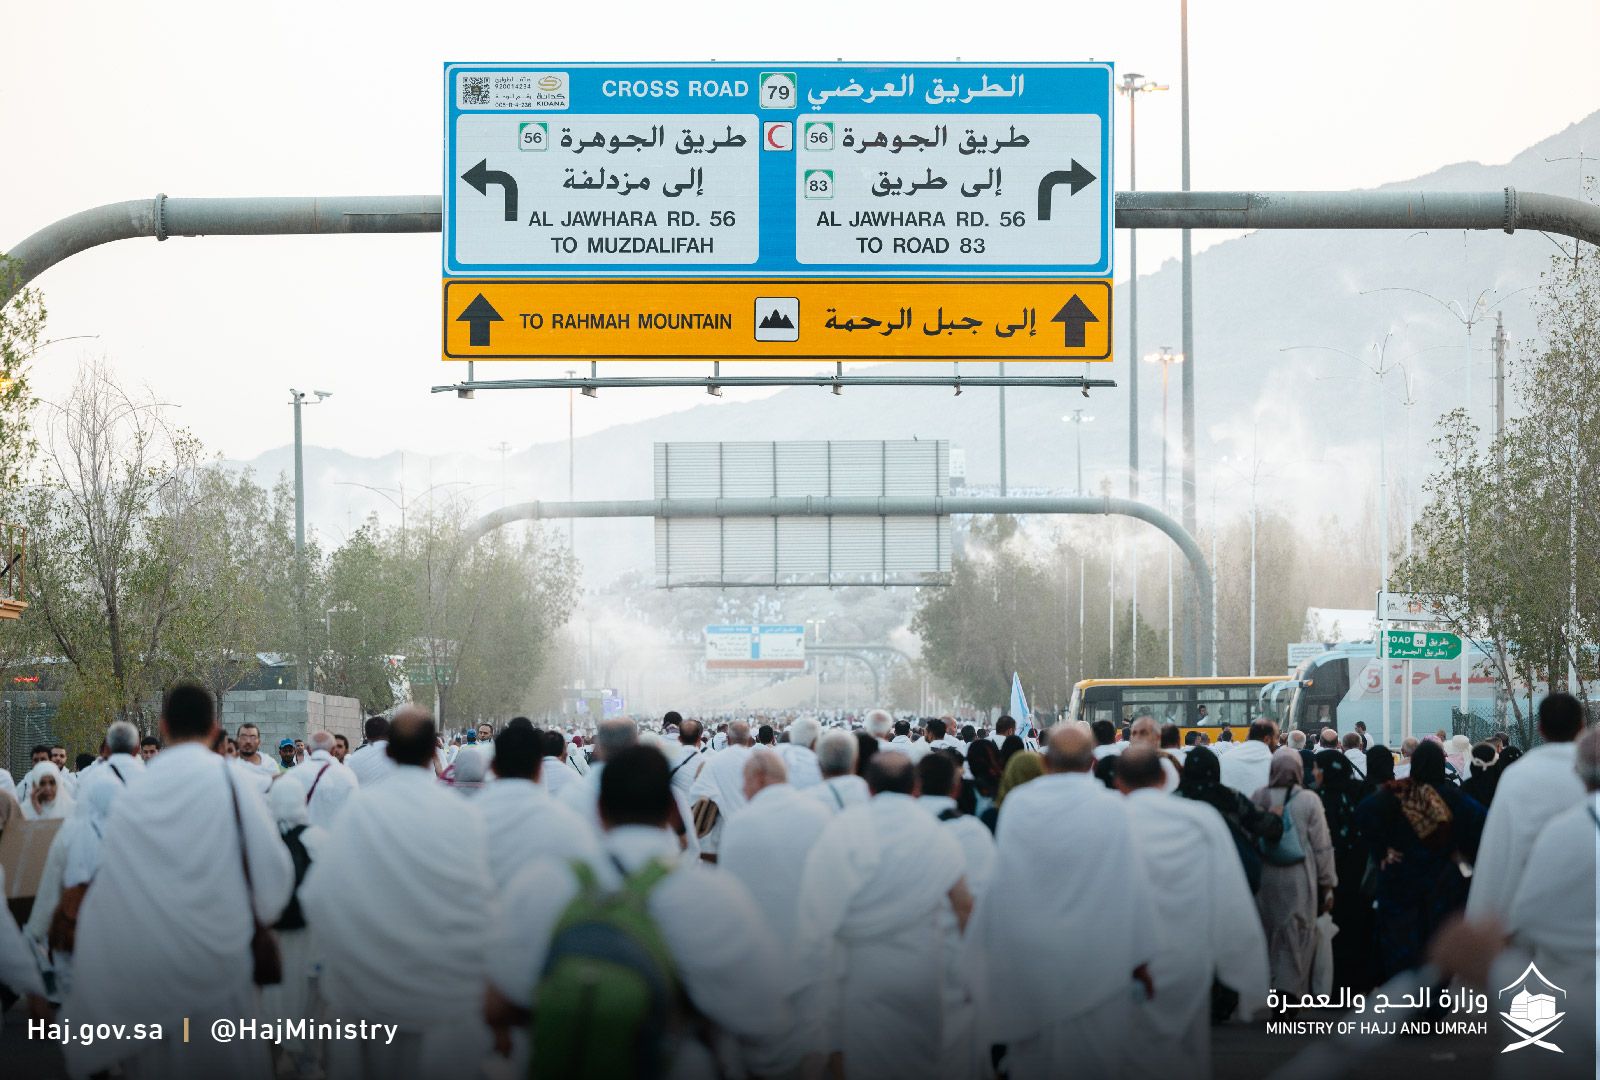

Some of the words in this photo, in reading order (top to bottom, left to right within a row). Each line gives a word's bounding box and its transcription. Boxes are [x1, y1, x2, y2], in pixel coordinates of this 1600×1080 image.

[602, 80, 679, 97] CROSS
[689, 80, 748, 97] ROAD
[768, 86, 789, 99] 79
[808, 74, 914, 110] العرضي
[926, 74, 1024, 104] الطريق
[524, 133, 542, 143] 56
[561, 125, 664, 154] الجوهرة
[675, 125, 747, 154] طريق
[810, 132, 827, 143] 56
[843, 125, 947, 154] الجوهرة
[959, 125, 1030, 155] طريق
[563, 167, 650, 196] مزدلفة
[663, 167, 703, 197] إلى
[810, 180, 827, 191] 83
[872, 168, 947, 197] طريق
[961, 167, 1001, 197] إلى
[529, 211, 553, 226] AL
[561, 211, 657, 226] JAWHARA
[668, 211, 699, 226] RD.
[710, 211, 735, 226] 56
[817, 211, 841, 226] AL
[849, 212, 945, 227] JAWHARA
[957, 212, 988, 226] RD.
[1000, 211, 1025, 227] 56
[551, 237, 577, 253] TO
[588, 238, 713, 253] MUZDALIFAH
[856, 237, 882, 253] TO
[894, 237, 949, 253] ROAD
[960, 238, 985, 253] 83
[520, 314, 543, 329] TO
[552, 314, 629, 329] RAHMAH
[639, 314, 731, 329] MOUNTAIN
[825, 307, 911, 336] الرحمة
[923, 307, 983, 336] جبل
[996, 307, 1036, 338] إلى
[1366, 668, 1380, 688] 5
